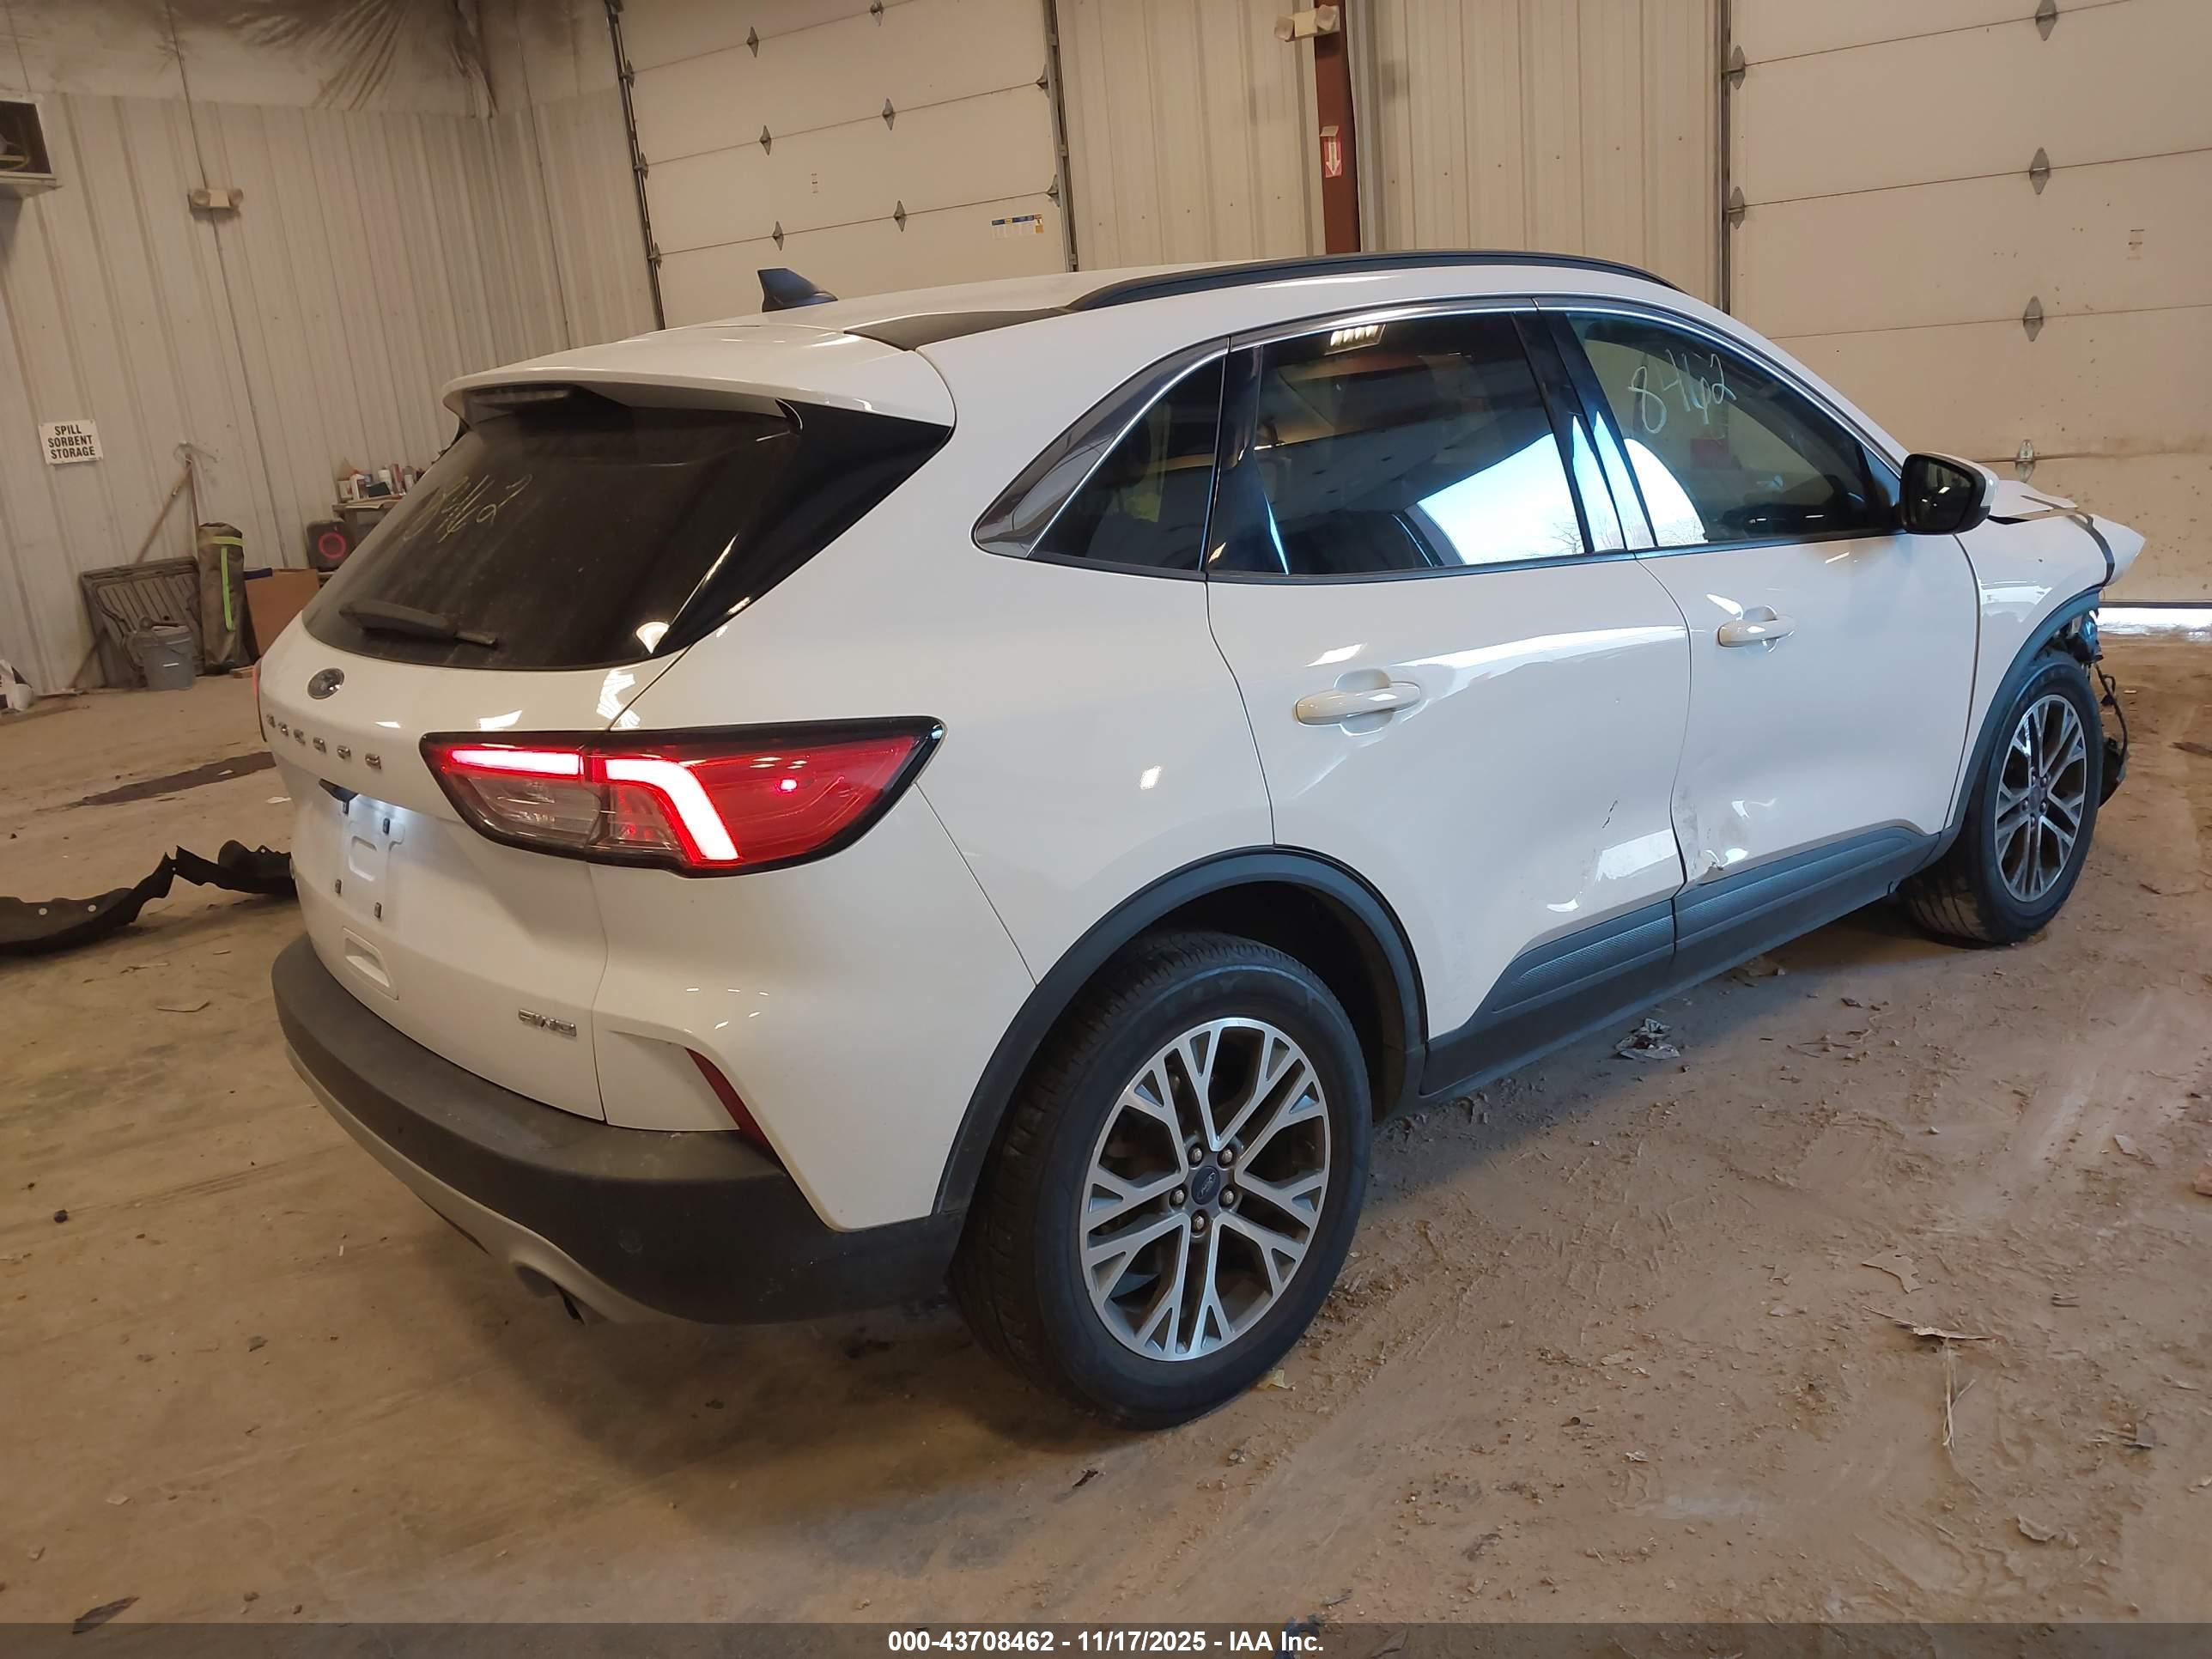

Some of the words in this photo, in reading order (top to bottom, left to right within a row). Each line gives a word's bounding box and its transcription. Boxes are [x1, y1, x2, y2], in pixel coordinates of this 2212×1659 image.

[54, 424, 82, 435] SPILL
[47, 434, 92, 447] SORBENT
[51, 446, 95, 459] STORAGE
